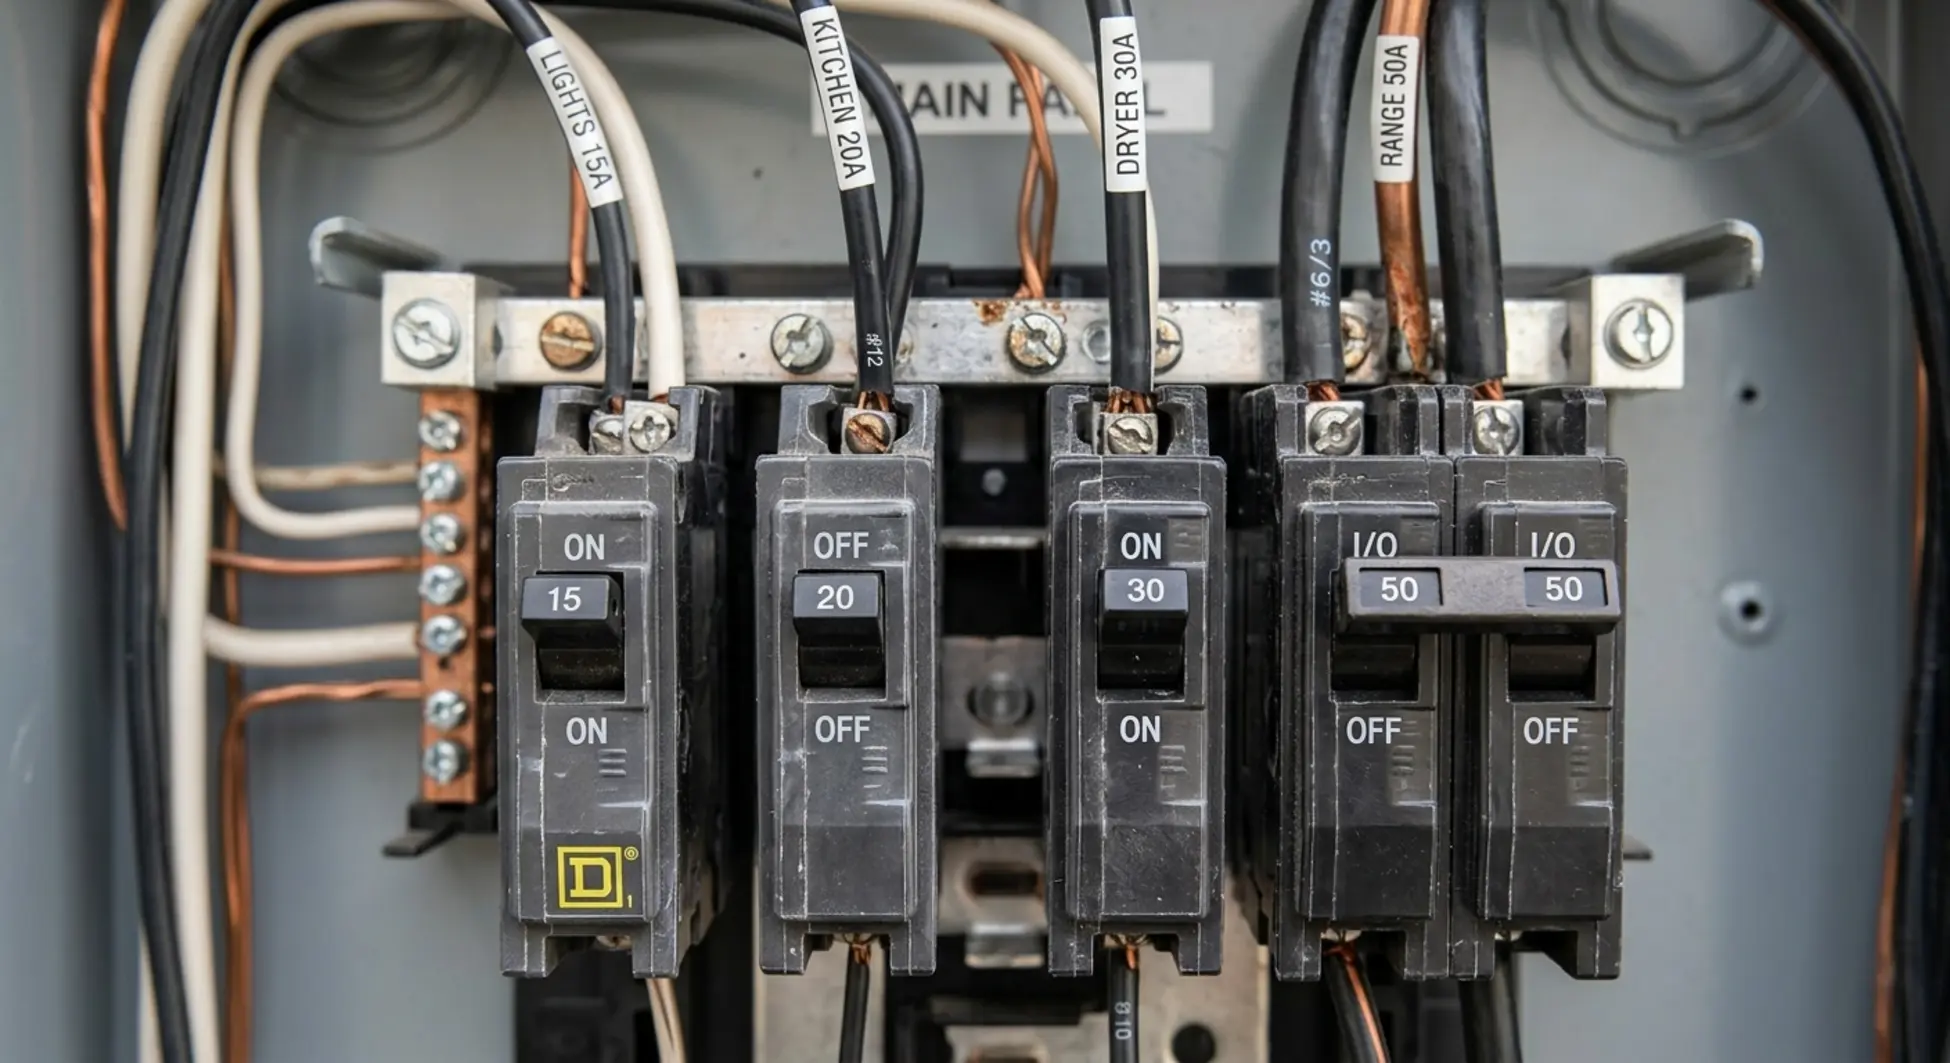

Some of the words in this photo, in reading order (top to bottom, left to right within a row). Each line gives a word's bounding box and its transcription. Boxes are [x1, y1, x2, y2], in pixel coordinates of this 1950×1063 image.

[1112, 33, 1137, 80] 30A
[1383, 44, 1408, 85] 50A
[812, 18, 857, 125] KITCHEN
[837, 131, 867, 179] 20A
[871, 81, 989, 118] AIN
[1009, 81, 1165, 118] PAL
[540, 50, 596, 137] LIGHTS
[582, 143, 613, 190] 15A
[1115, 90, 1140, 175] DRYER
[1380, 93, 1405, 166] RANGE
[1309, 238, 1331, 308] #6/3
[564, 533, 605, 561] ON
[813, 531, 869, 560] OFF
[1121, 532, 1161, 560] ON
[1353, 531, 1398, 558] I/O
[1531, 531, 1576, 558] I/O
[547, 586, 582, 612] 15
[816, 584, 855, 610] 20
[1126, 577, 1165, 603] 30
[1380, 575, 1419, 602] 50
[1545, 575, 1584, 602] 50
[566, 716, 607, 745] ON
[815, 715, 871, 743] OFF
[1120, 715, 1161, 743] ON
[1346, 716, 1402, 744] OFF
[1523, 716, 1579, 745] OFF
